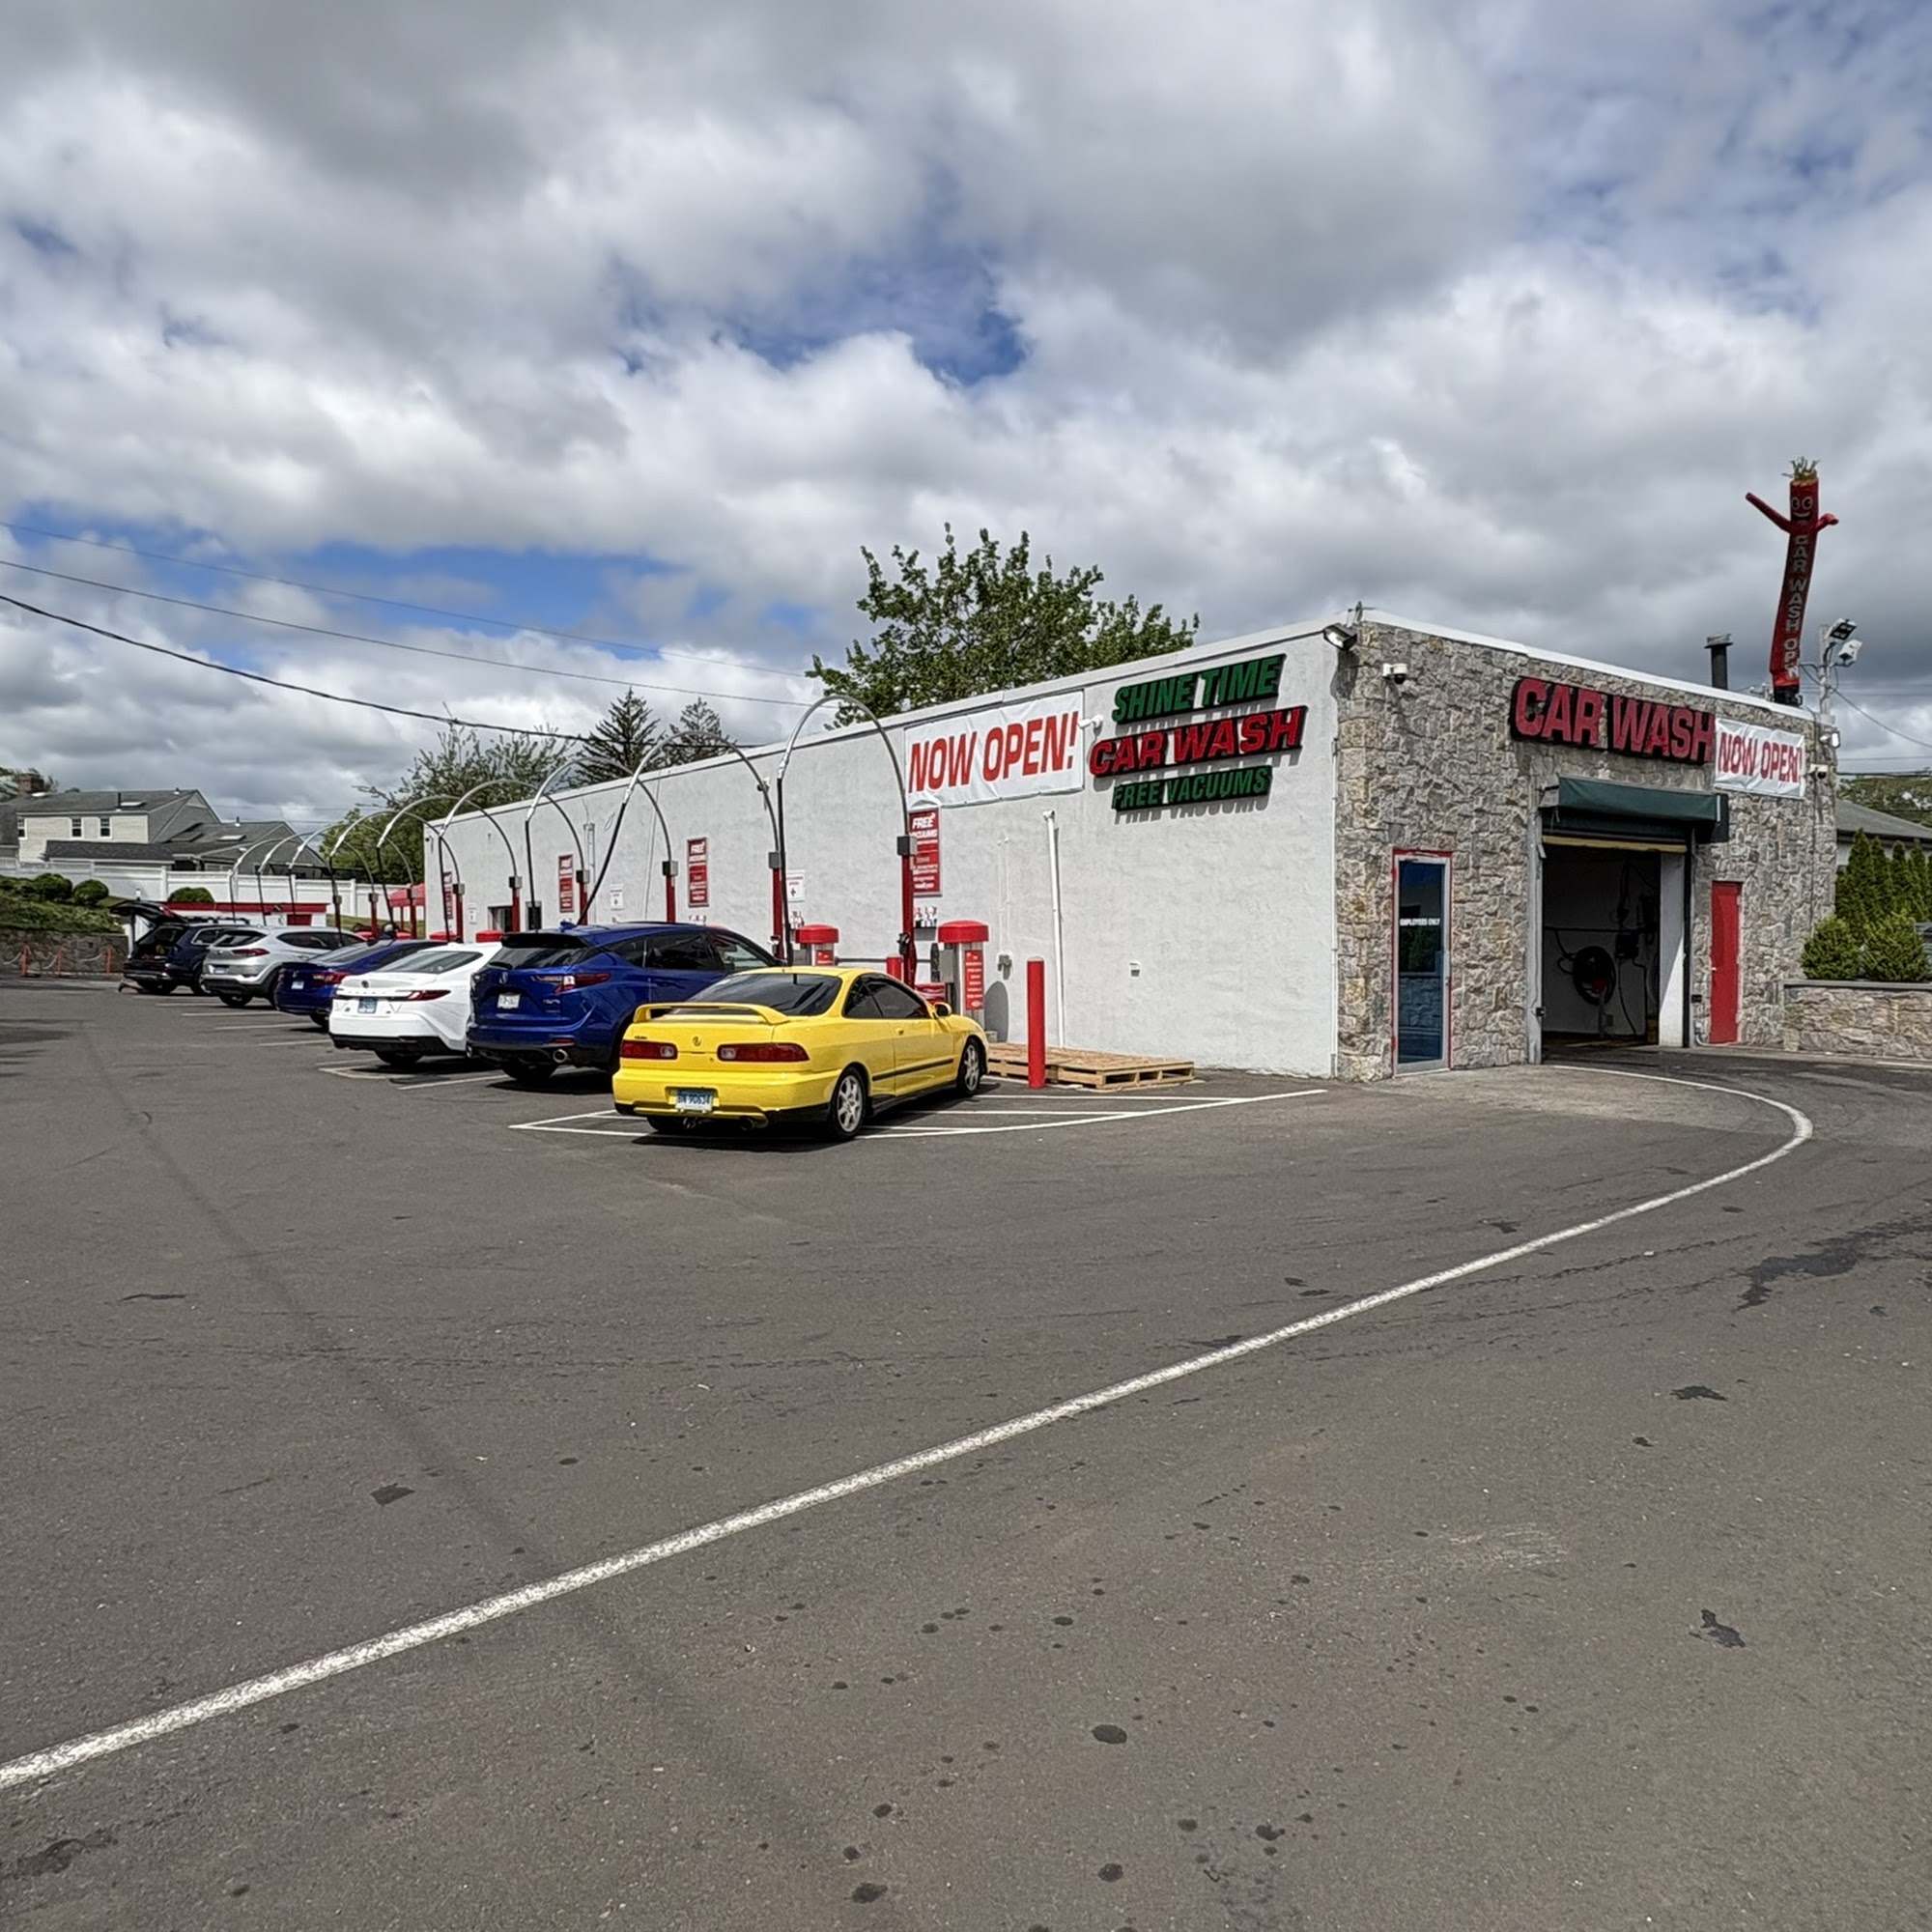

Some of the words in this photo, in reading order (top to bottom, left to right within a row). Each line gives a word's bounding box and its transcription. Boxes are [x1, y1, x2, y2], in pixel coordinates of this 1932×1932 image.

[1793, 534, 1808, 573] CAR
[1784, 579, 1807, 632] WASH
[1112, 673, 1196, 724] SHINE
[1201, 655, 1283, 708] TIME
[1089, 730, 1168, 776] CAR
[1172, 707, 1303, 764] WASH
[1515, 677, 1603, 746] CAR
[1611, 695, 1715, 762] WASH
[908, 731, 978, 793] NOW
[982, 711, 1079, 781] OPEN!
[1719, 732, 1758, 777] NOW
[1112, 781, 1160, 810] FREE
[1166, 766, 1270, 805] VACUUMS
[912, 815, 934, 830] FREE
